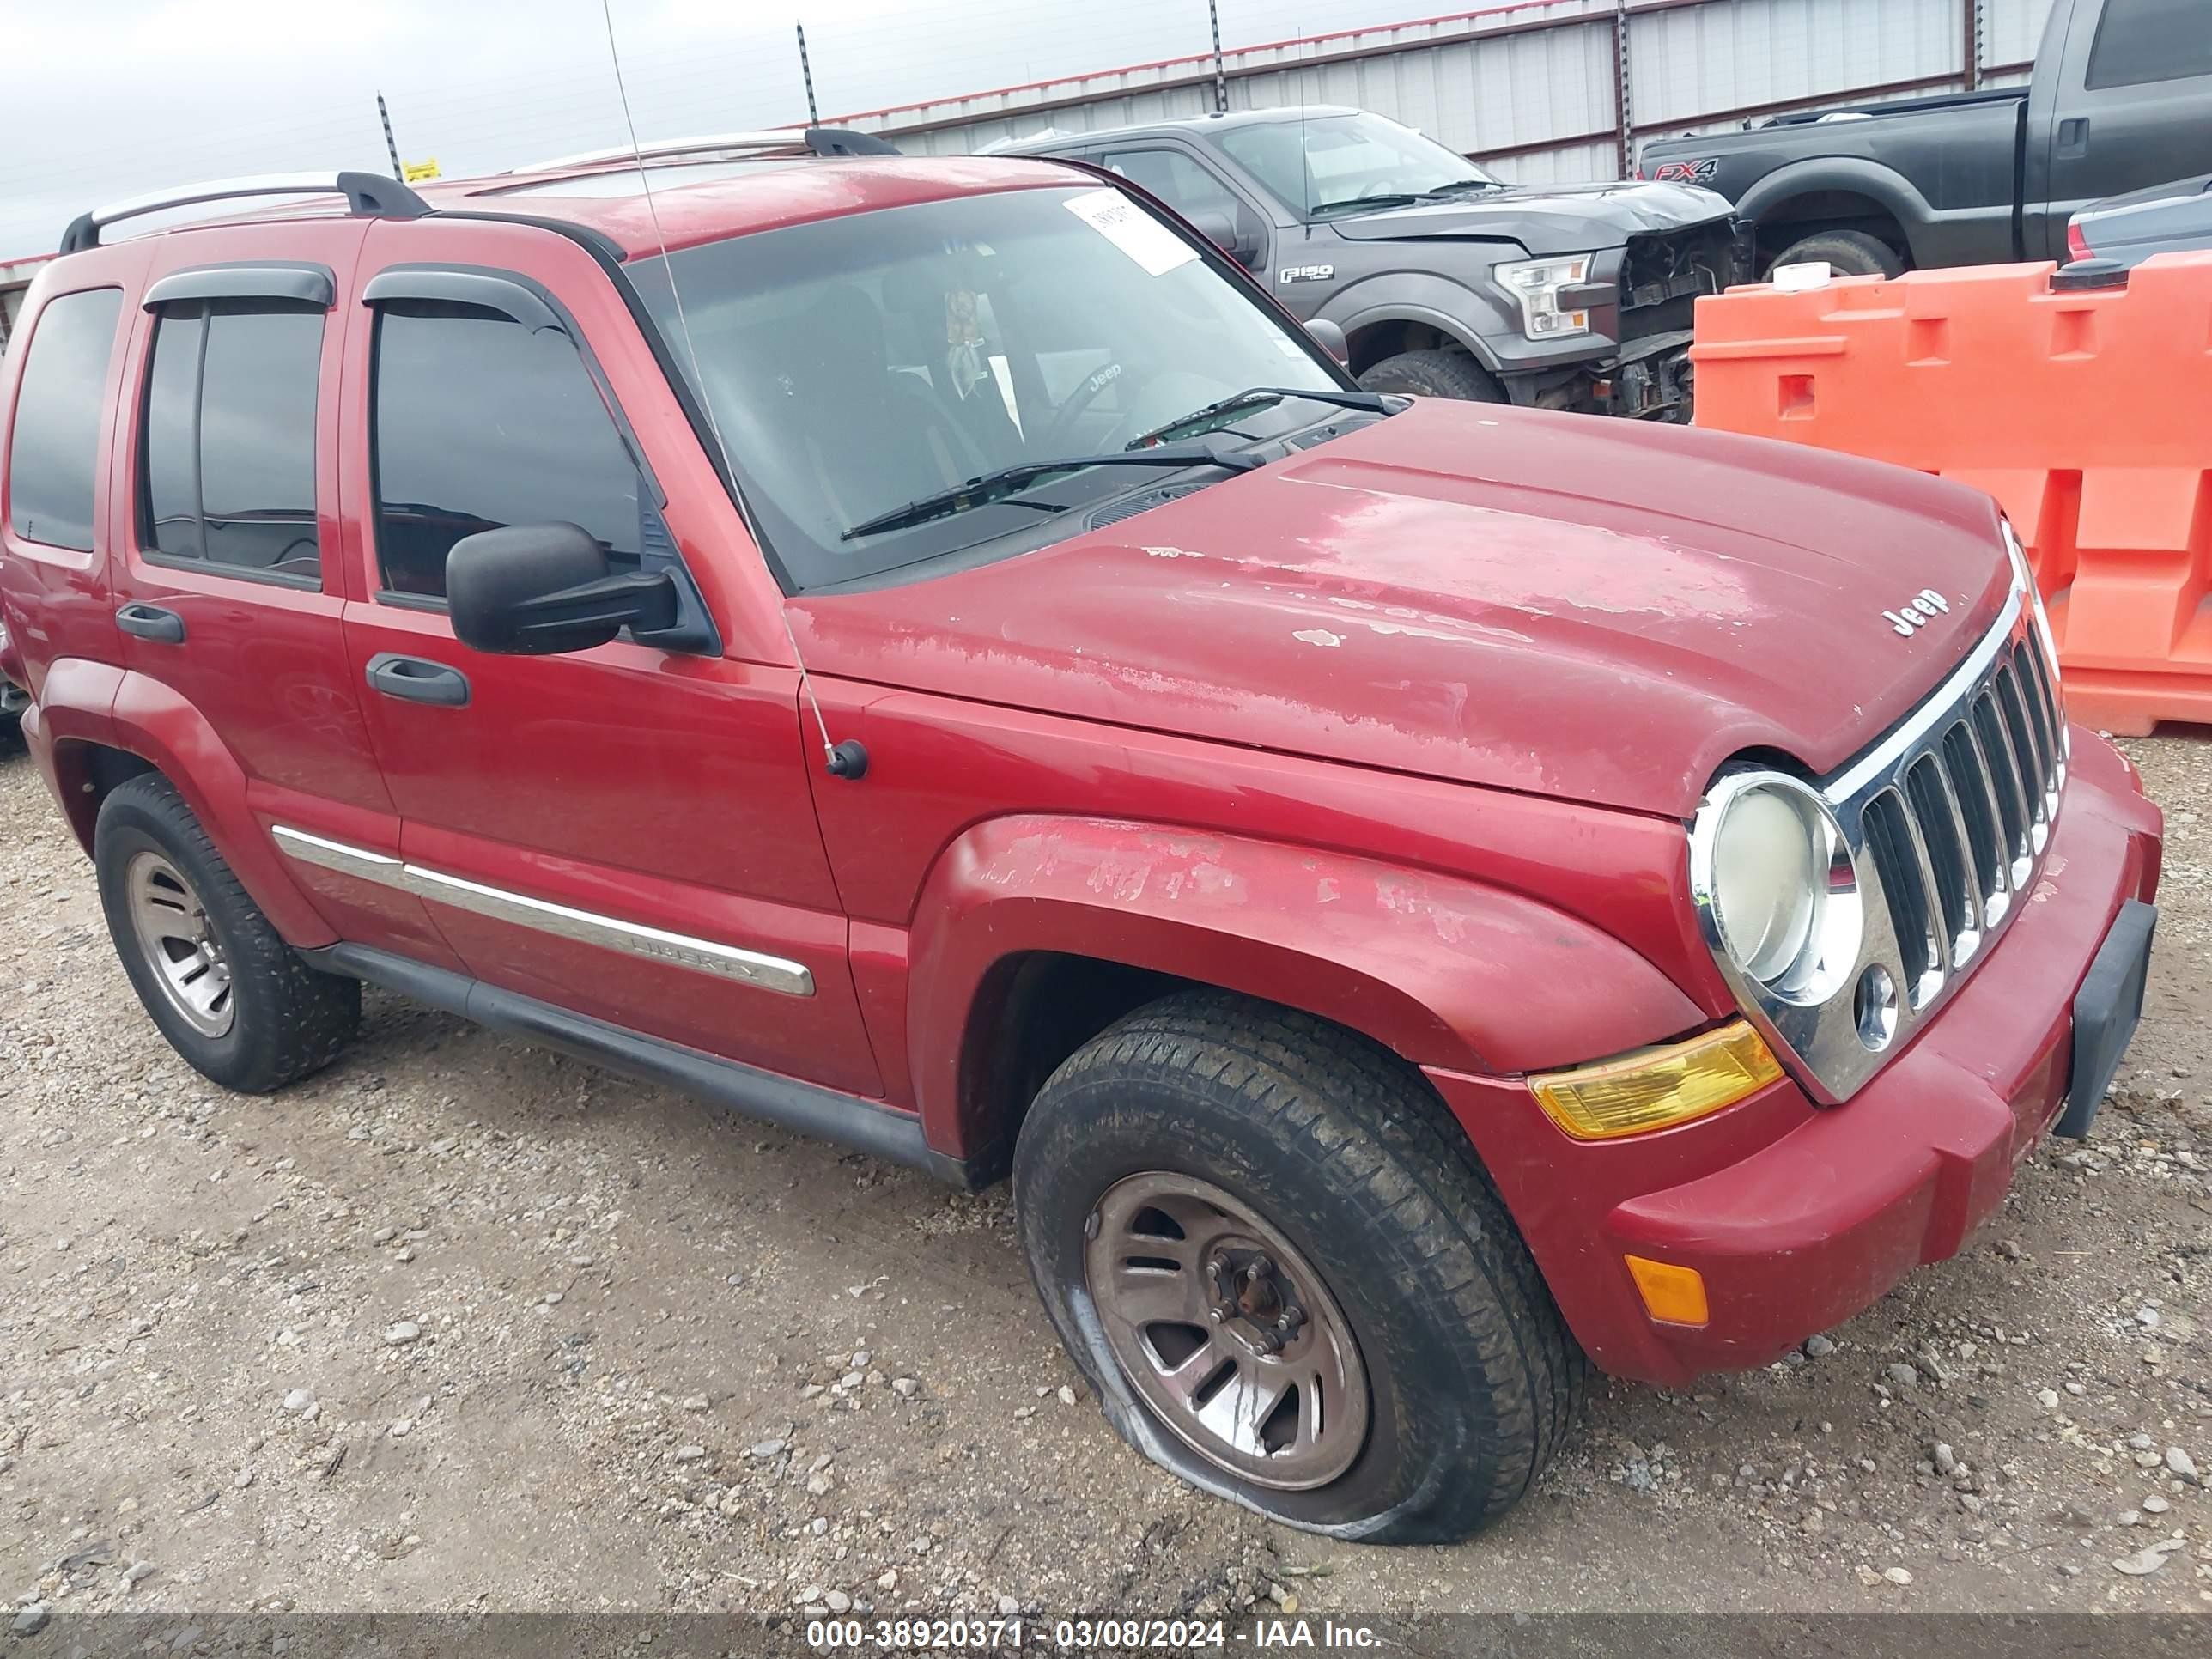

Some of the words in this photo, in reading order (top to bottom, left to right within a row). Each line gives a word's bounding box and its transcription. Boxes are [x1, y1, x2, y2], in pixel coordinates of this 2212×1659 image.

[1654, 157, 1719, 182] FX4
[1090, 363, 1121, 392] Jeep
[1881, 589, 1949, 637] Jeep
[630, 937, 760, 980] LIBERTY
